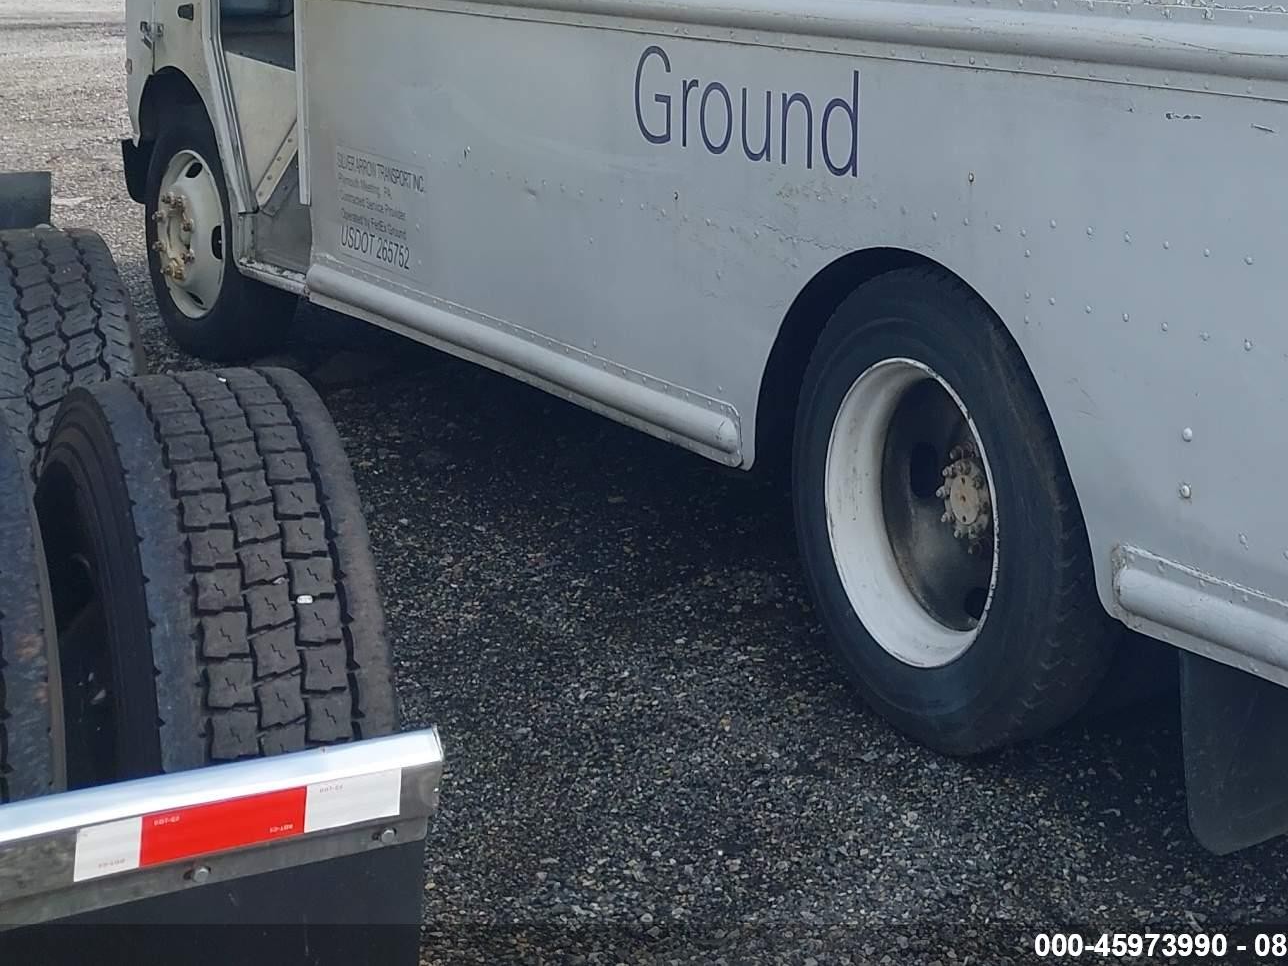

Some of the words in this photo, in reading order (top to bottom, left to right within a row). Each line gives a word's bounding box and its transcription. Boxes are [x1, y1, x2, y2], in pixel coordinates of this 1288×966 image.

[634, 45, 859, 178] Ground
[376, 163, 412, 190] TRANSPORT
[341, 225, 375, 255] USDOT
[376, 236, 410, 270] 265752
